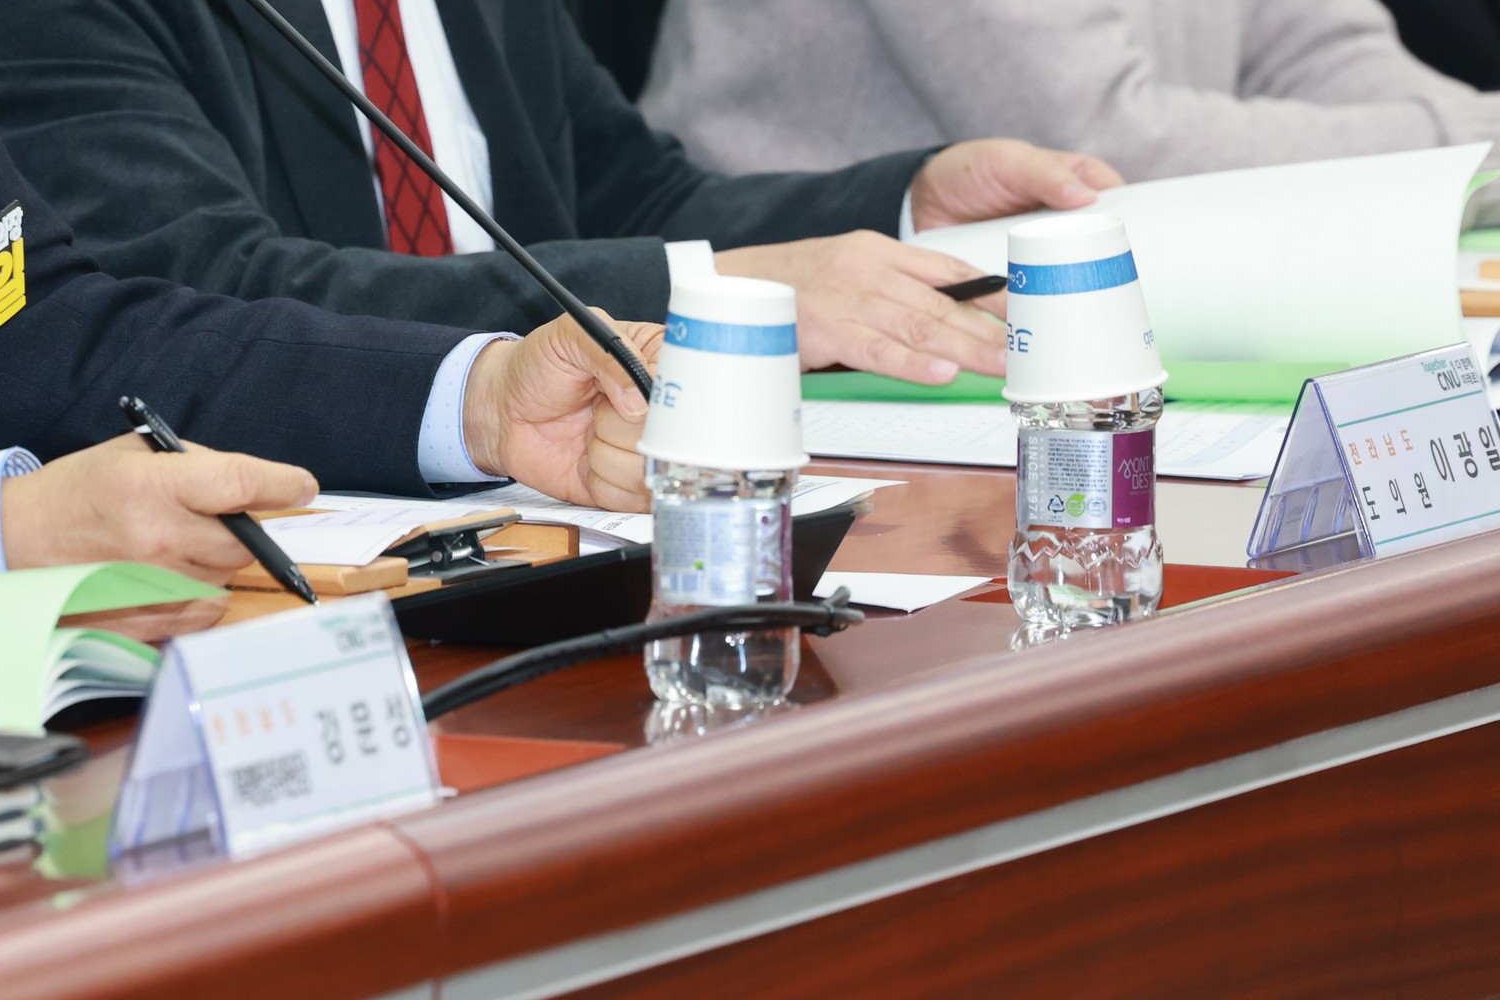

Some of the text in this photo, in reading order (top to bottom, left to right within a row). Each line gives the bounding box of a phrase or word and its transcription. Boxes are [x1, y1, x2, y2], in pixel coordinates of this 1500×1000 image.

[1437, 360, 1461, 391] CNU
[1028, 436, 1039, 521] SINCE 1974
[1429, 425, 1500, 482] 이광일
